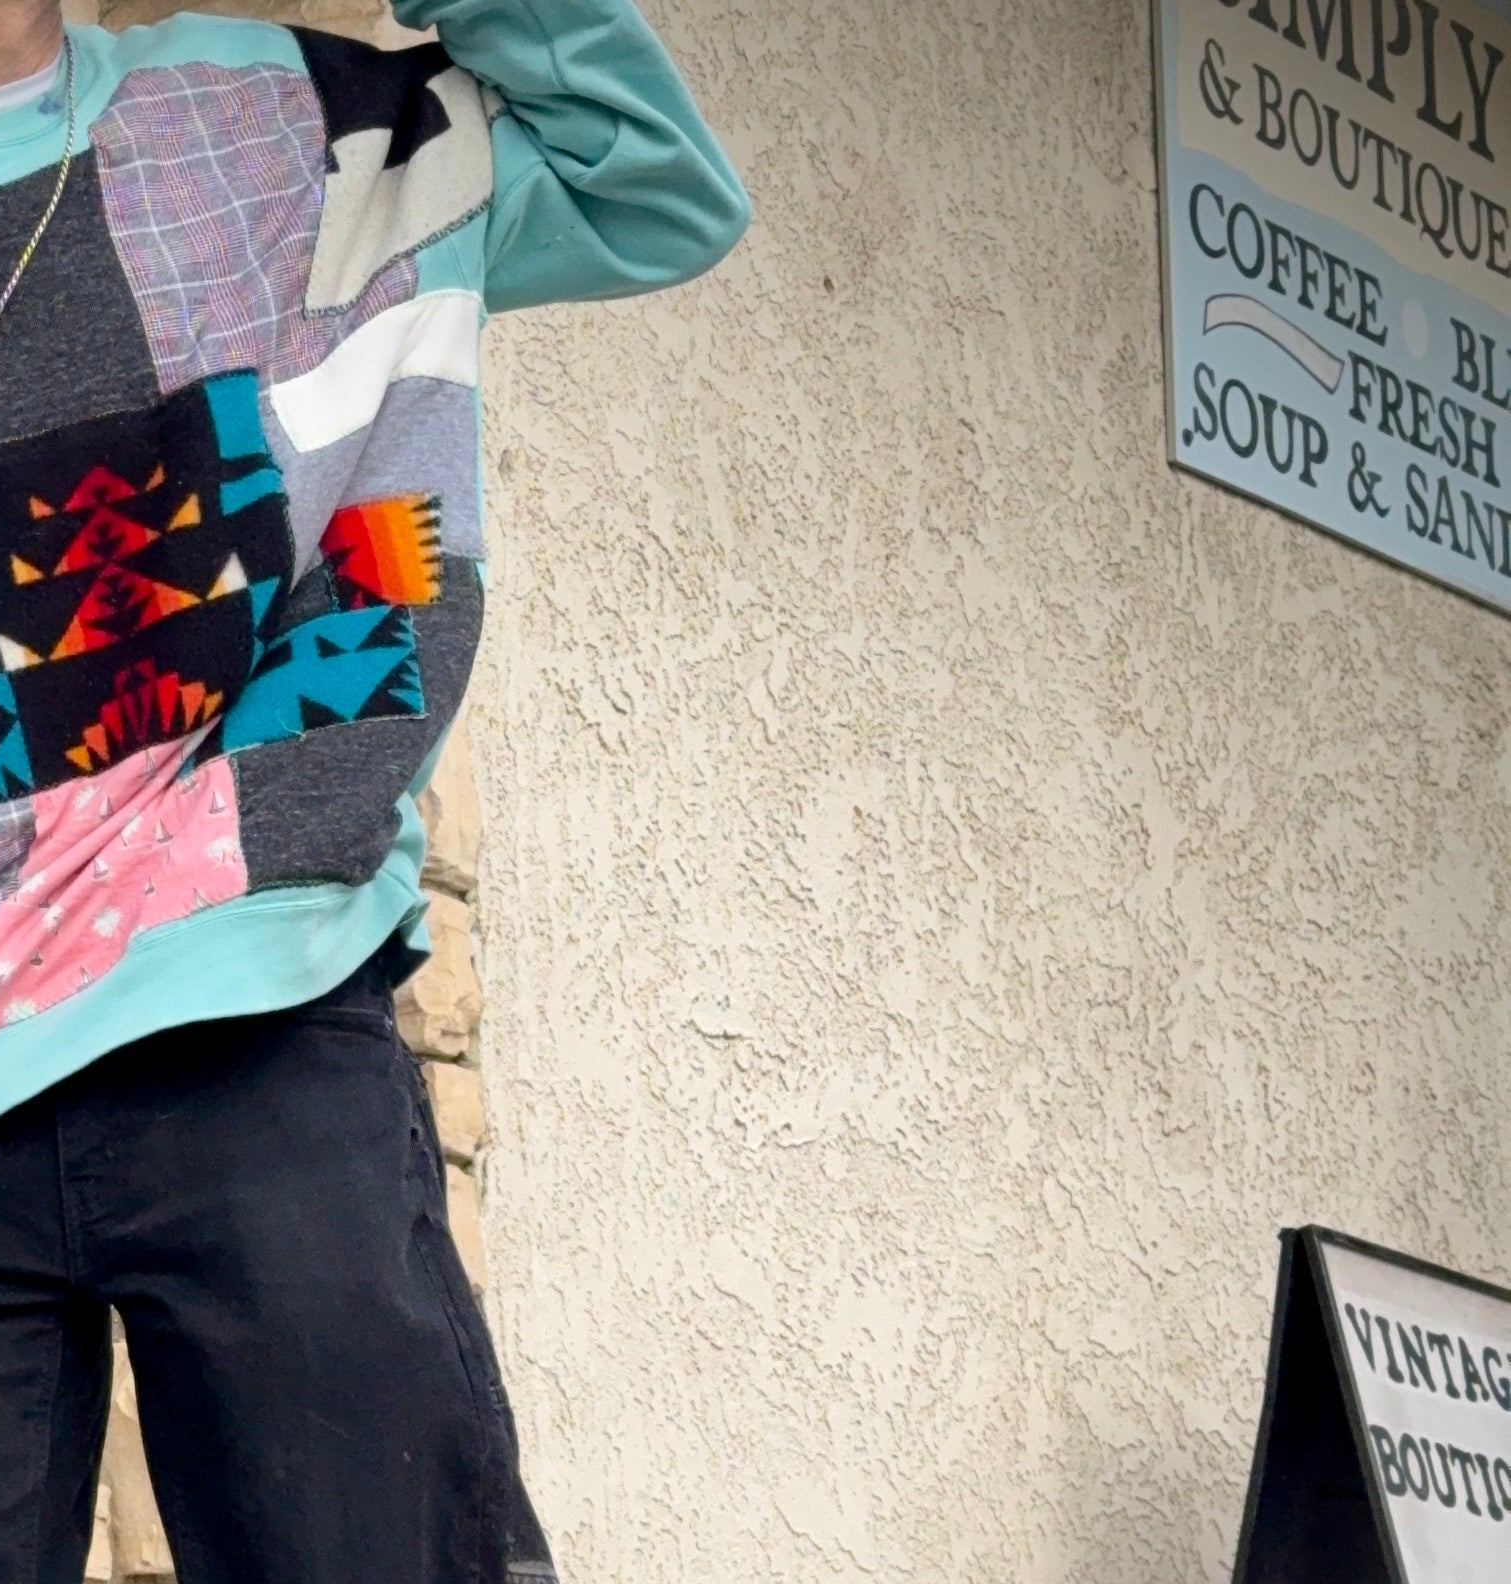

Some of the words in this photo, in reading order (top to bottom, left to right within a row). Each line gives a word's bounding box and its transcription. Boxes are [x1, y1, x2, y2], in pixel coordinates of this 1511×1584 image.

[1219, 0, 1504, 163] MPLY
[1199, 38, 1244, 125] &
[1252, 62, 1511, 279] BOUTIQUE
[1190, 183, 1388, 348] COFFEE
[1450, 317, 1511, 413] BL
[1347, 350, 1501, 488] FRESH
[1348, 441, 1390, 518] &
[1344, 1302, 1511, 1411] VINTAG
